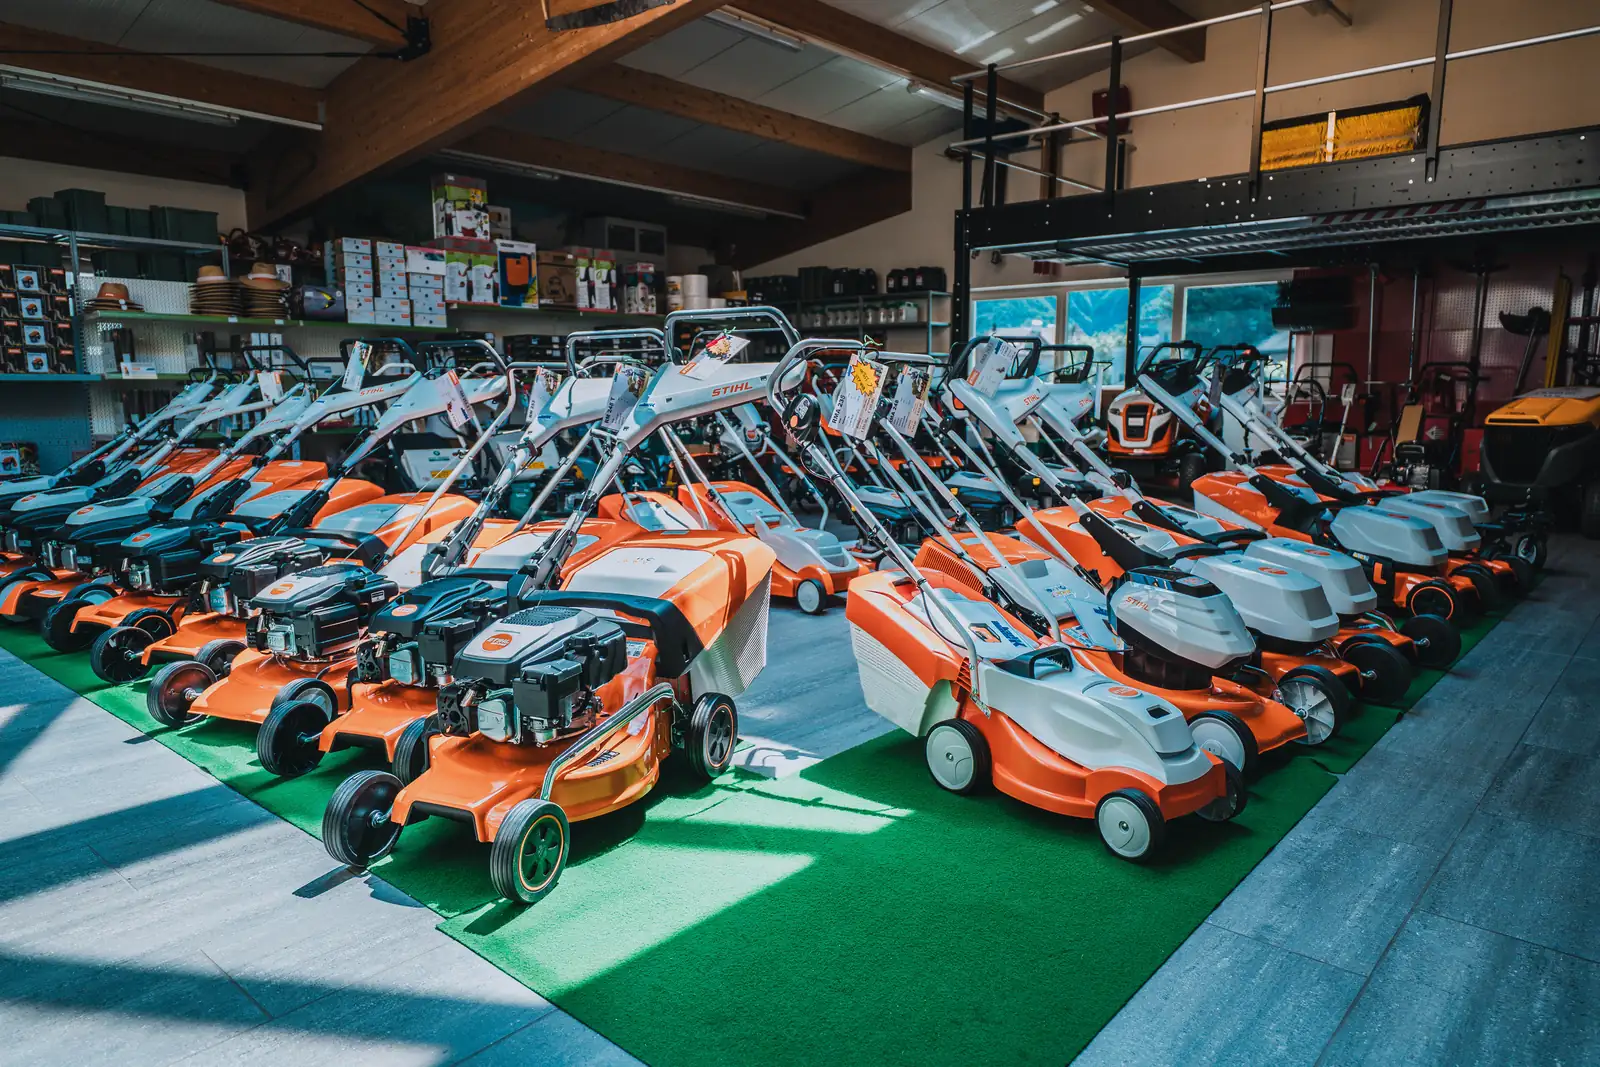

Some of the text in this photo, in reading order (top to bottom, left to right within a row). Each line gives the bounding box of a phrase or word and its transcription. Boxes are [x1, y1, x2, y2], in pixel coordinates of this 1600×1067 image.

[360, 387, 385, 396] STIHL
[711, 381, 753, 397] STIHL
[1023, 394, 1040, 406] STIHL
[831, 394, 846, 424] RMA 235
[1126, 596, 1150, 612] STIHL
